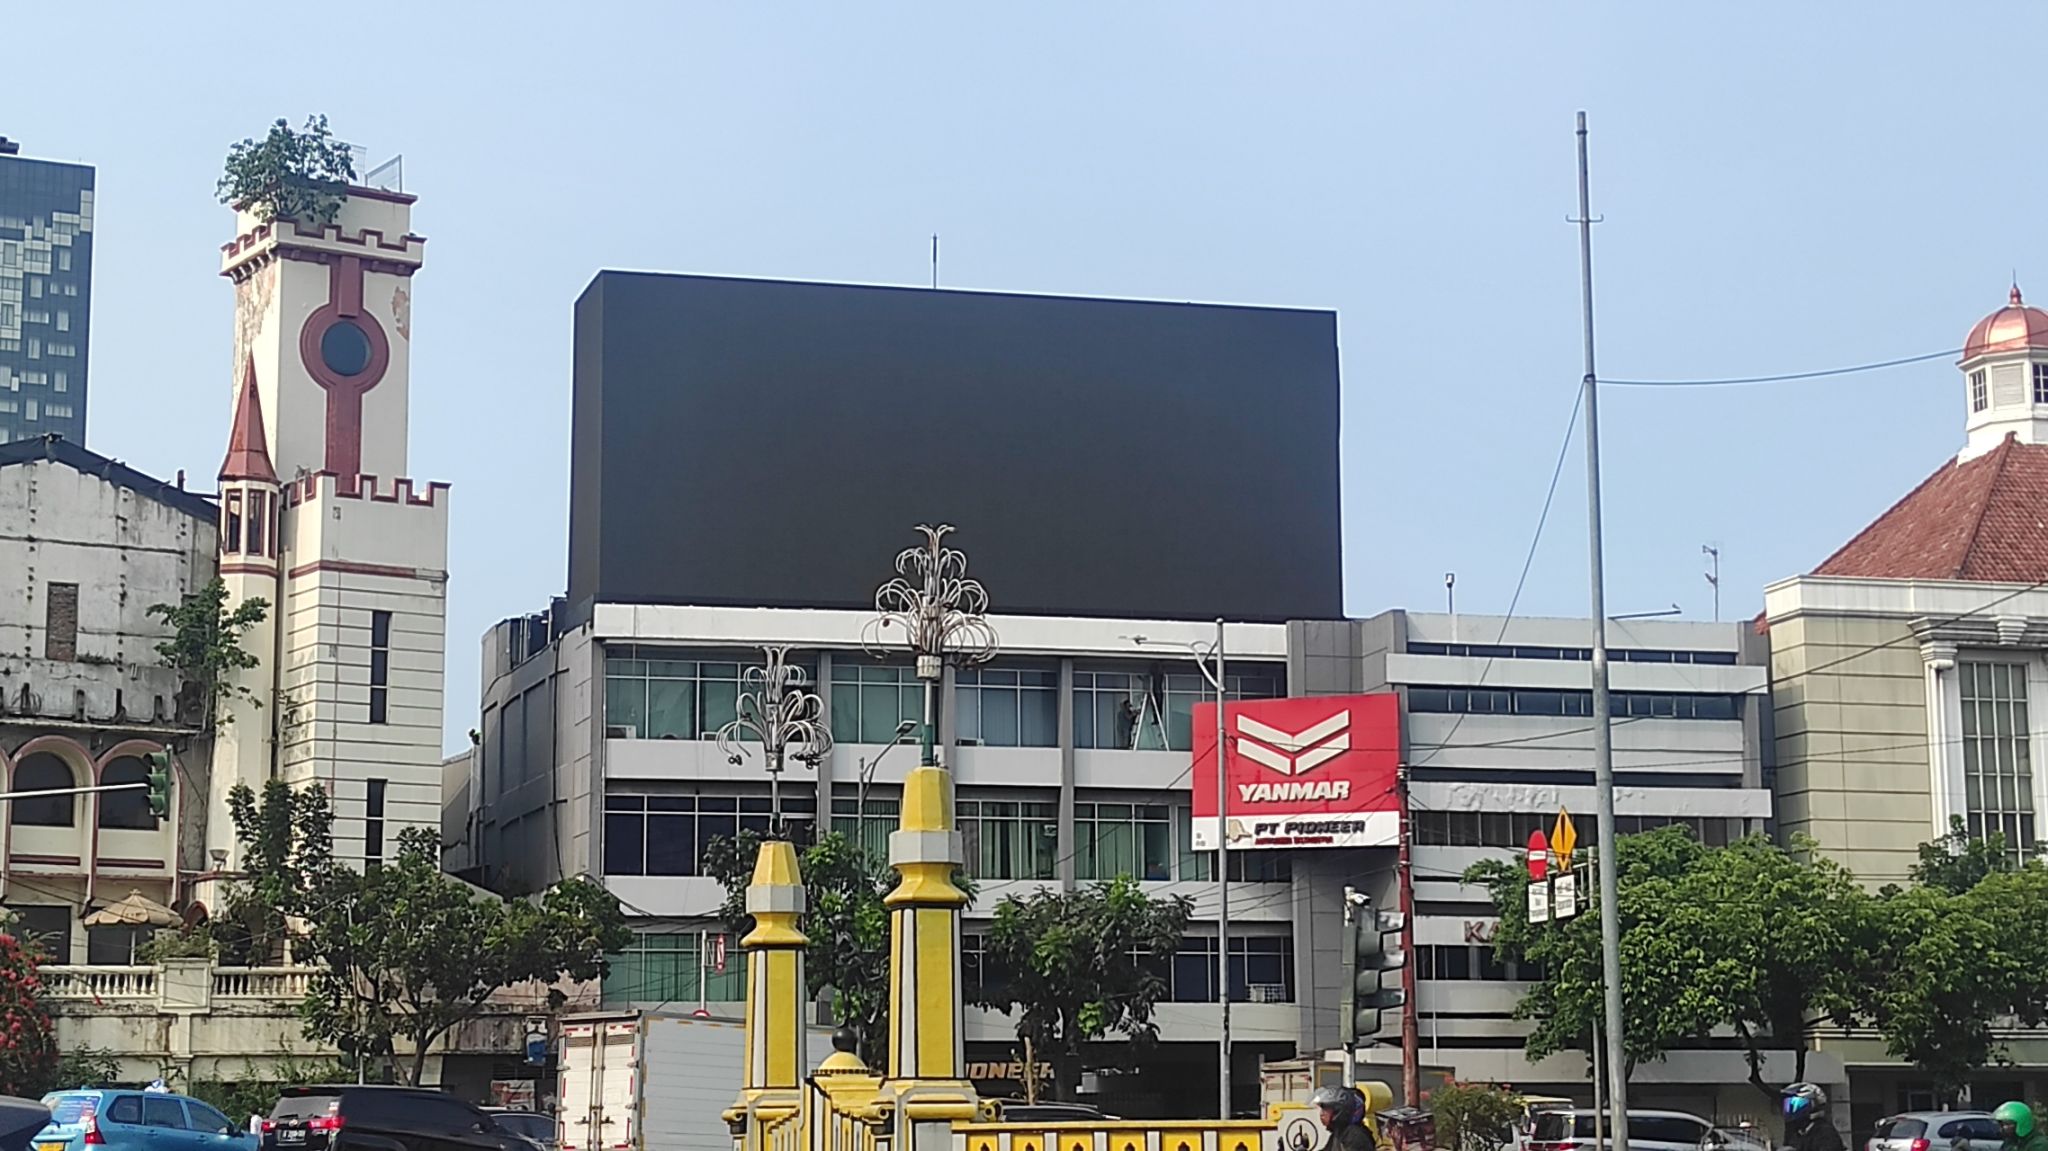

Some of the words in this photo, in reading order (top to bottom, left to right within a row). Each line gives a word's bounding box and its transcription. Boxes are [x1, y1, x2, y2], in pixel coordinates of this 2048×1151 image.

[1238, 780, 1350, 803] YANMAR
[1254, 823, 1280, 836] PT
[1284, 820, 1365, 834] PIONEER
